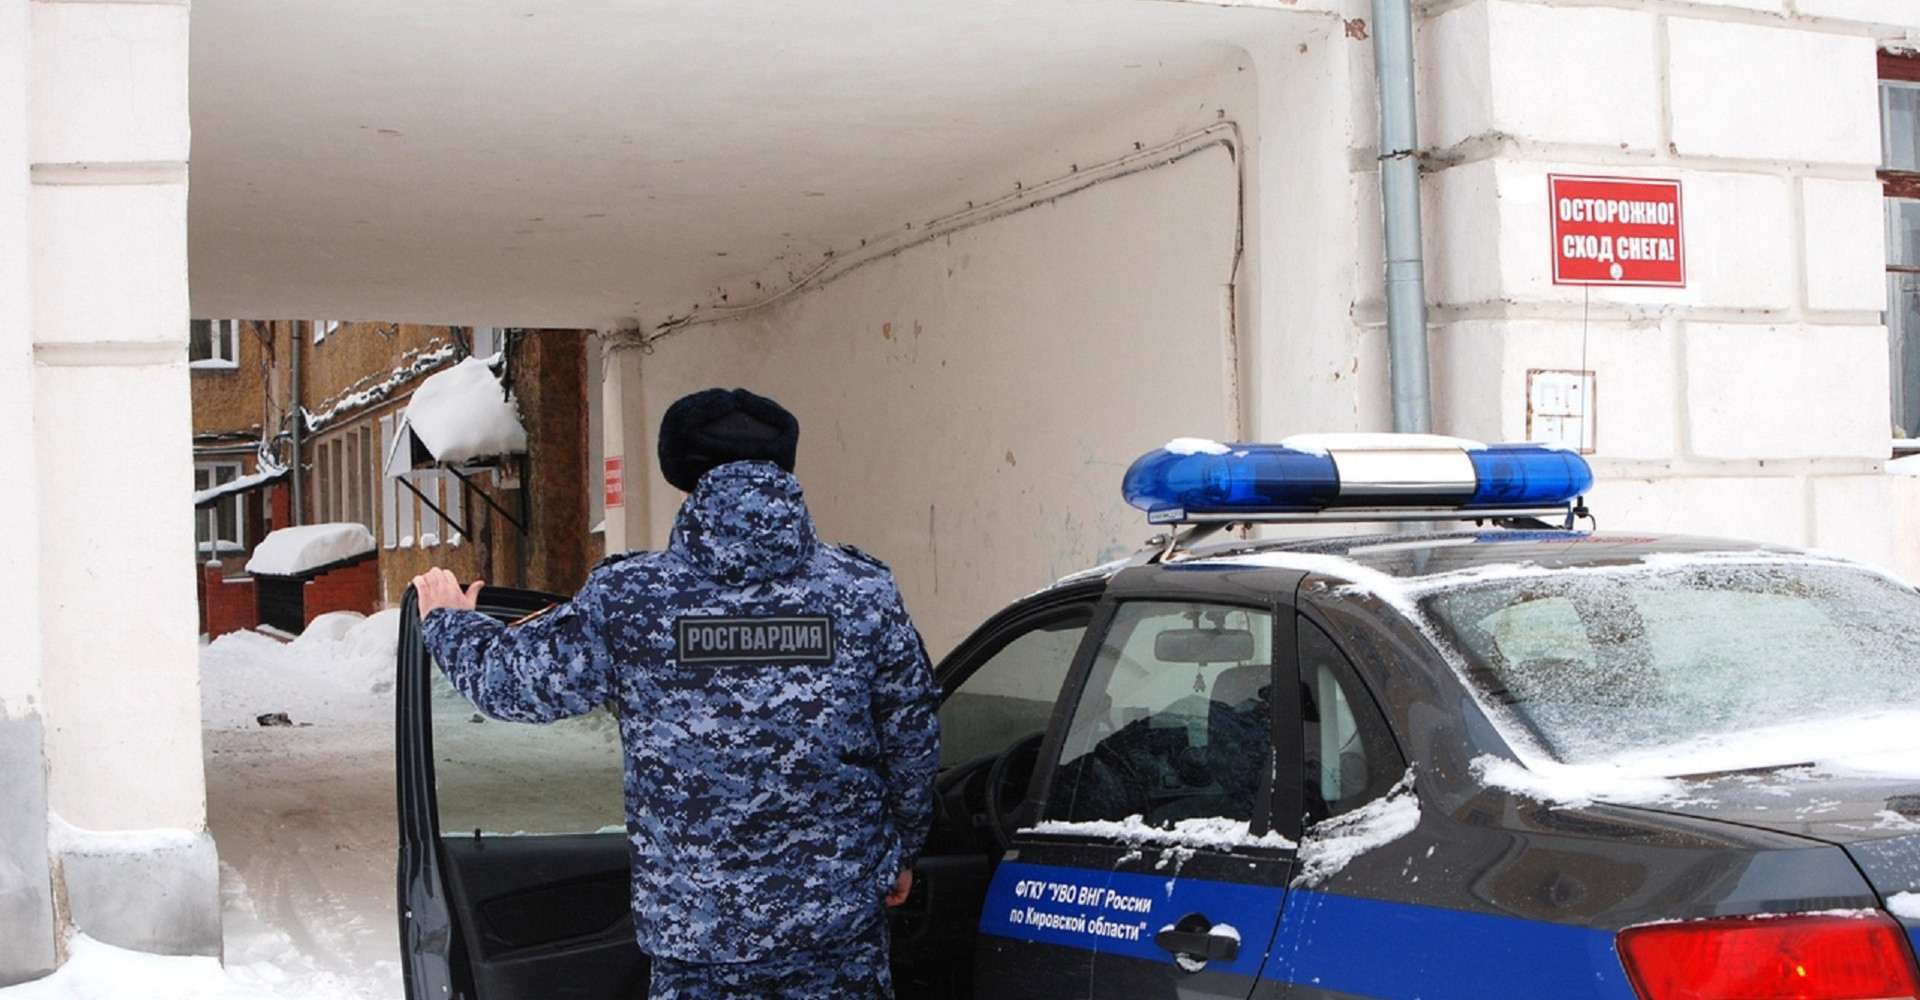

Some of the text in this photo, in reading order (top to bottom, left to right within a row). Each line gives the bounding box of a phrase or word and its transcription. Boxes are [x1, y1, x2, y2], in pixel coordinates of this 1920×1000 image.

[1559, 198, 1675, 225] ОСТОРОЖНО!
[1562, 234, 1675, 263] СХОД СНЕГА!
[687, 625, 822, 651] РОСГВАРДИЯ
[1015, 880, 1152, 913] ФГКУ "УВО ВНГ России
[1009, 907, 1147, 941] по Кировской области"
